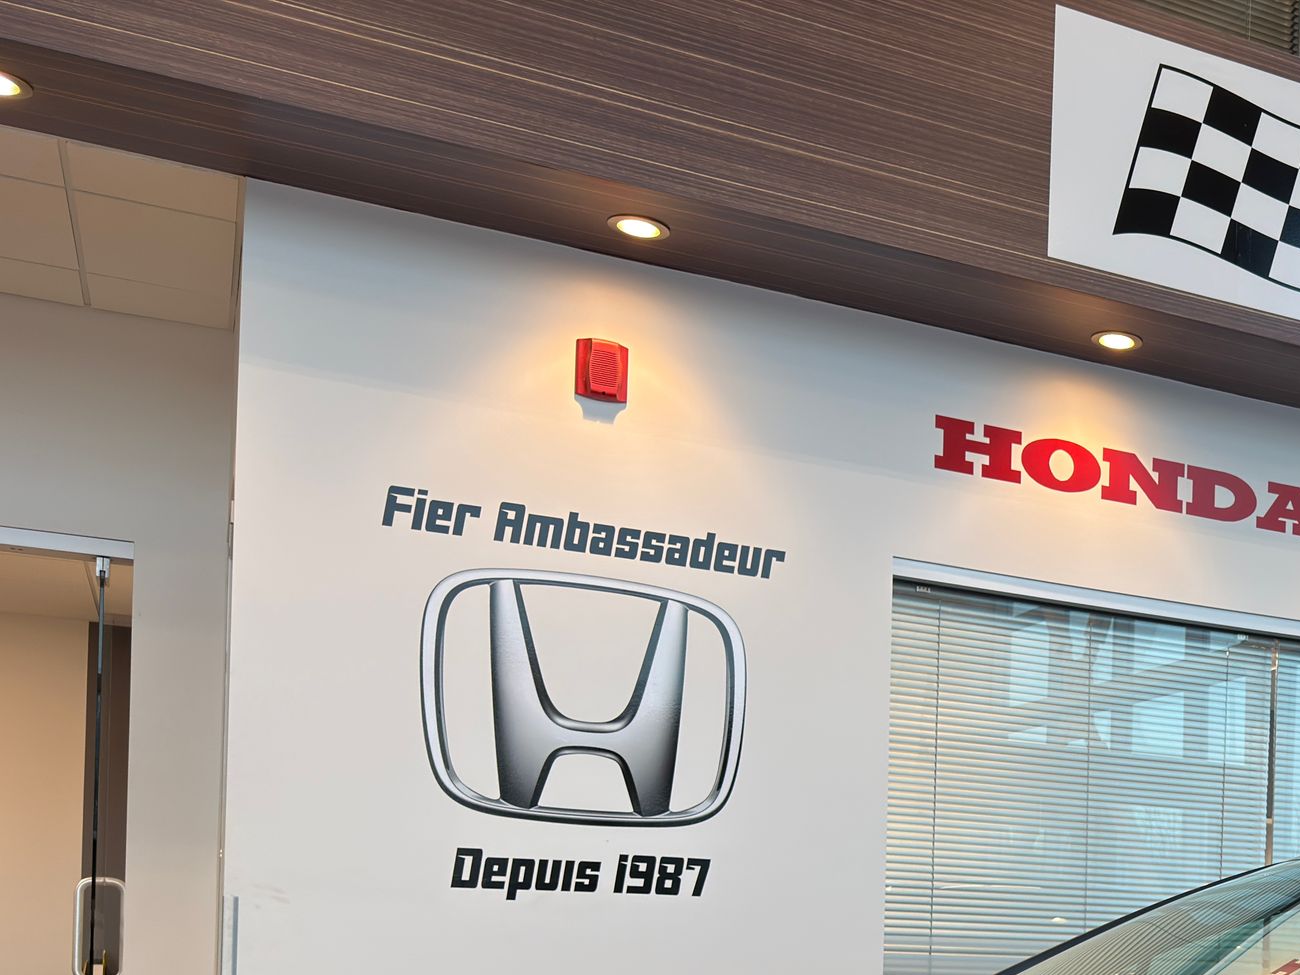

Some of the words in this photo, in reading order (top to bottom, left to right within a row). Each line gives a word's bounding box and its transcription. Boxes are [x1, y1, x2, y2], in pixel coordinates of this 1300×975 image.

[382, 485, 481, 536] Fier
[494, 502, 786, 579] Ambassadeur
[450, 848, 601, 900] Depuis
[613, 854, 711, 897] 1987
